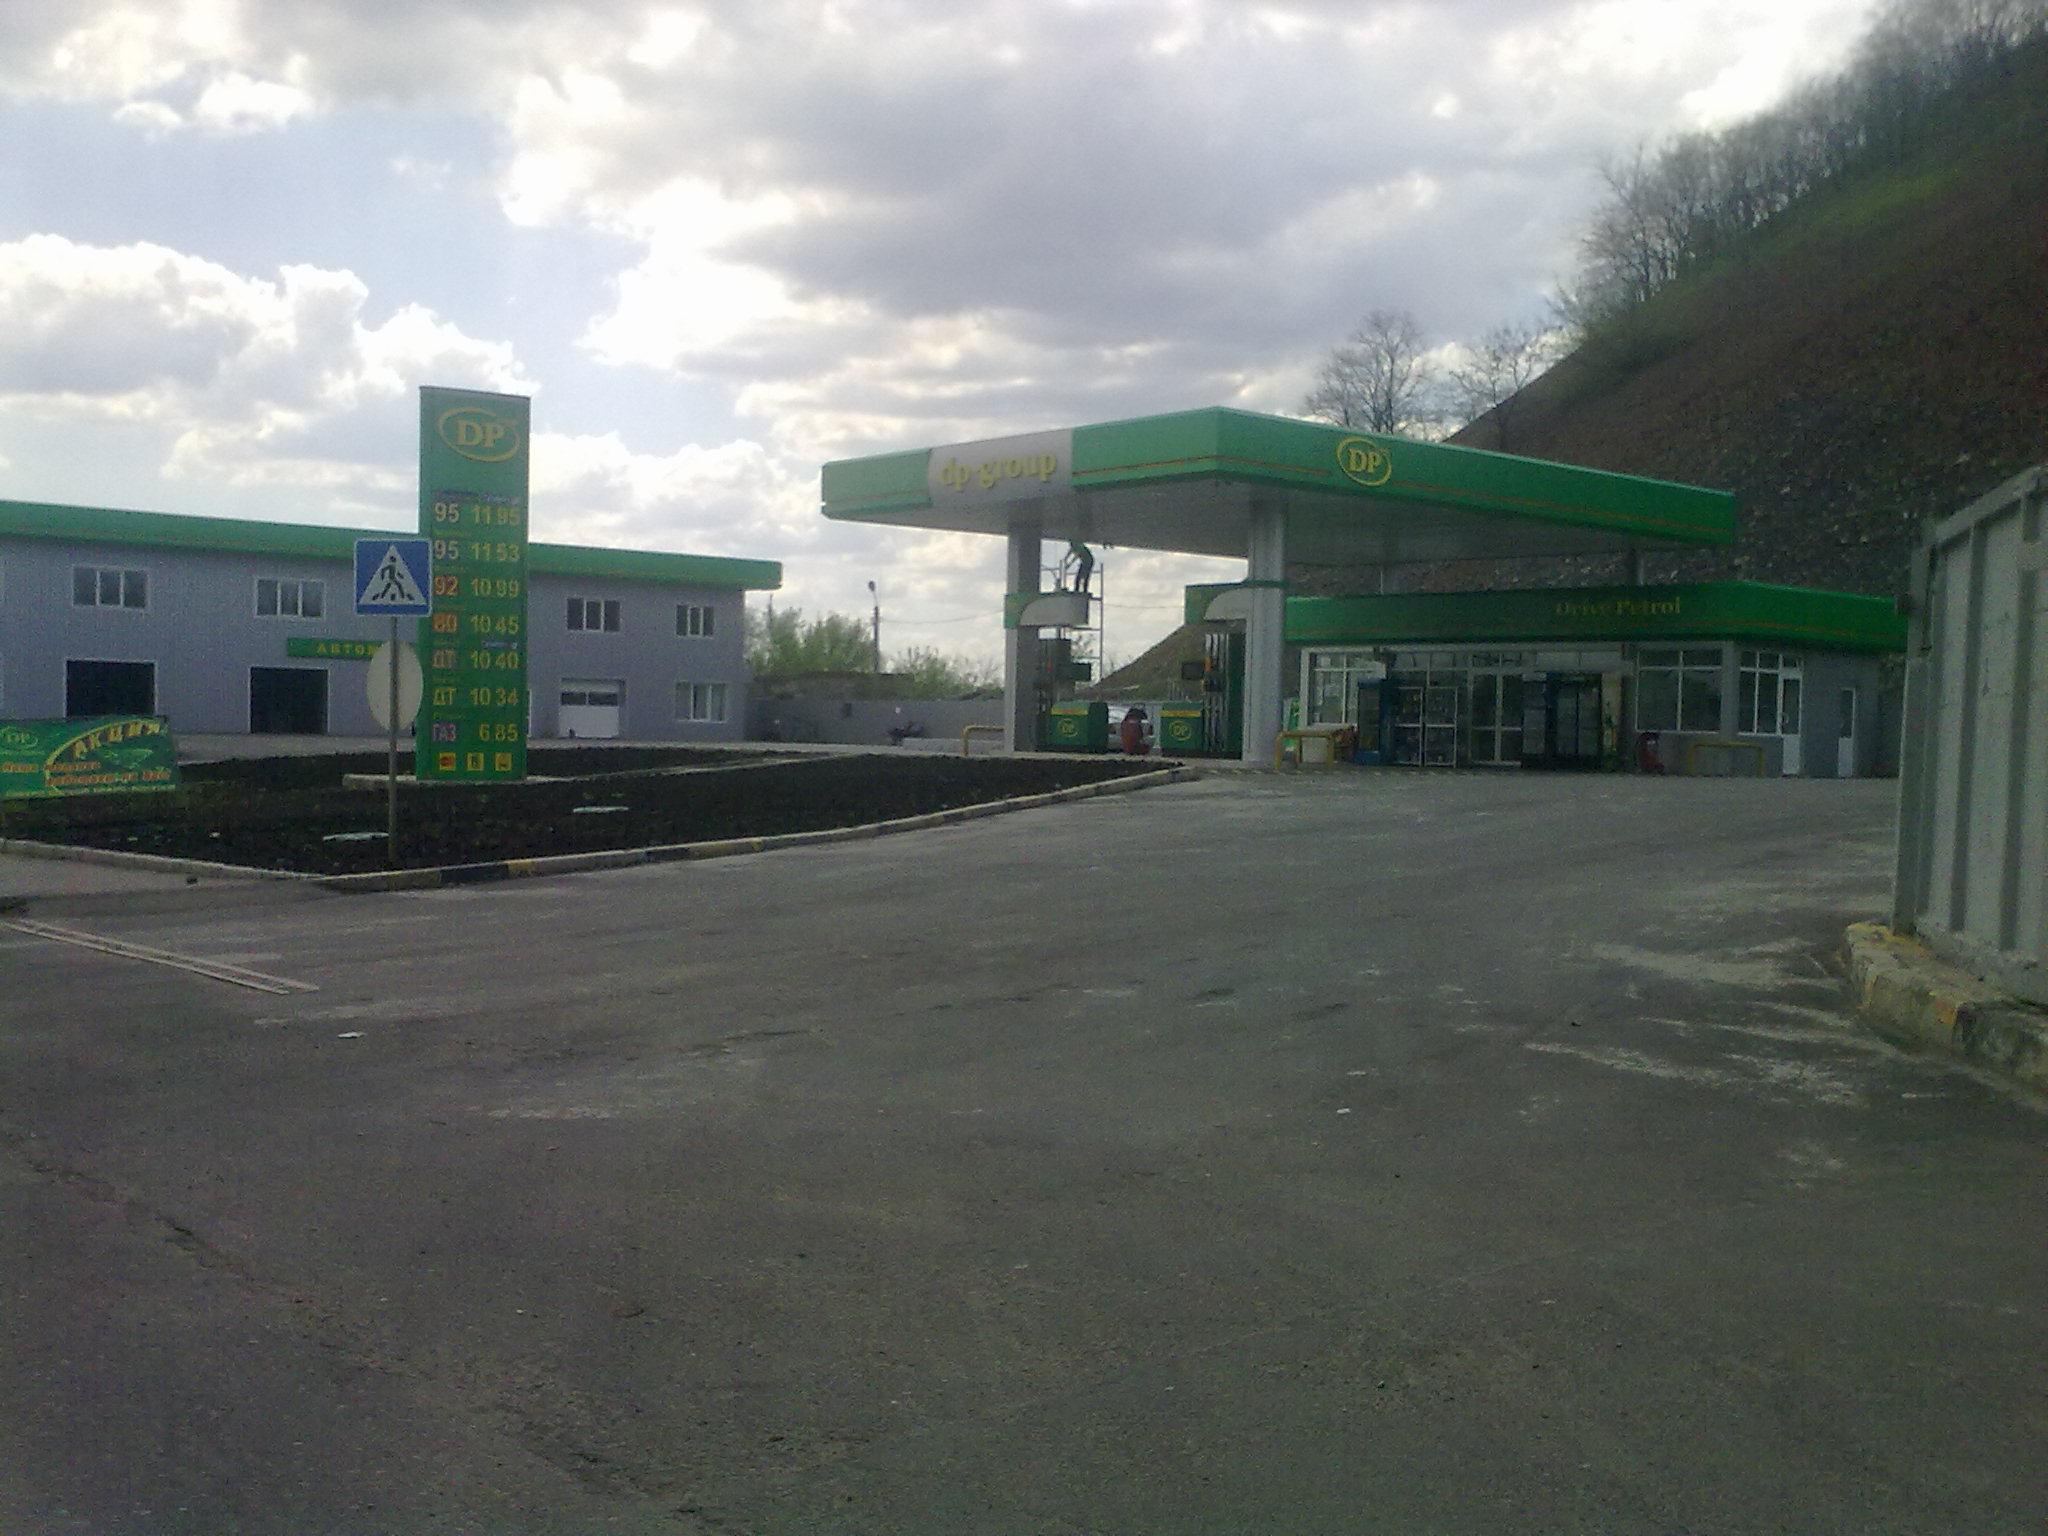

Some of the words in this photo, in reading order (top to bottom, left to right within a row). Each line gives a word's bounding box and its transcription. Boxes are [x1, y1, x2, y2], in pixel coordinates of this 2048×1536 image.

[456, 419, 505, 447] DP
[1348, 449, 1381, 472] DP
[434, 502, 460, 522] 95
[434, 540, 459, 560] 95
[434, 576, 458, 595] 92
[433, 687, 457, 705] ДТ
[432, 724, 457, 742] ГАЗ
